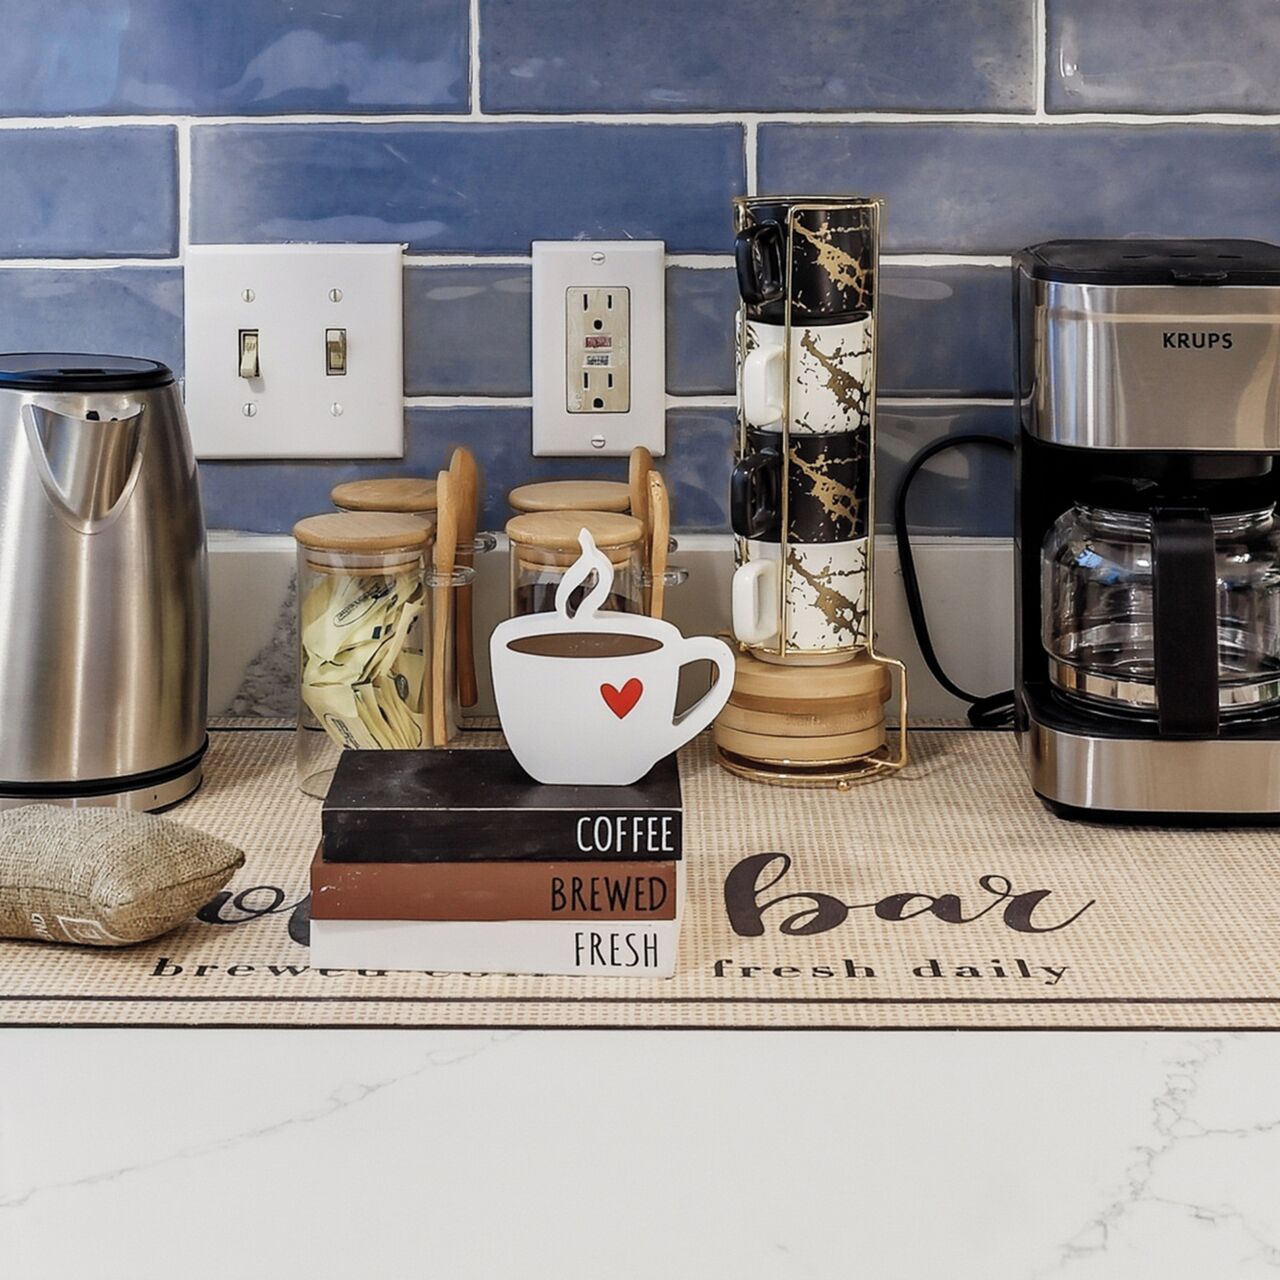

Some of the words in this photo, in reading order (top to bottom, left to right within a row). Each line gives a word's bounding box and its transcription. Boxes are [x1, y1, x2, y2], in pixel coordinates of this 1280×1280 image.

[1162, 332, 1233, 349] KRUPS
[576, 816, 675, 853] COFFEE
[551, 876, 668, 912] BREWED
[723, 852, 1096, 937] bar
[575, 932, 659, 968] FRESH
[713, 959, 878, 979] fresh
[912, 959, 1072, 986] daily
